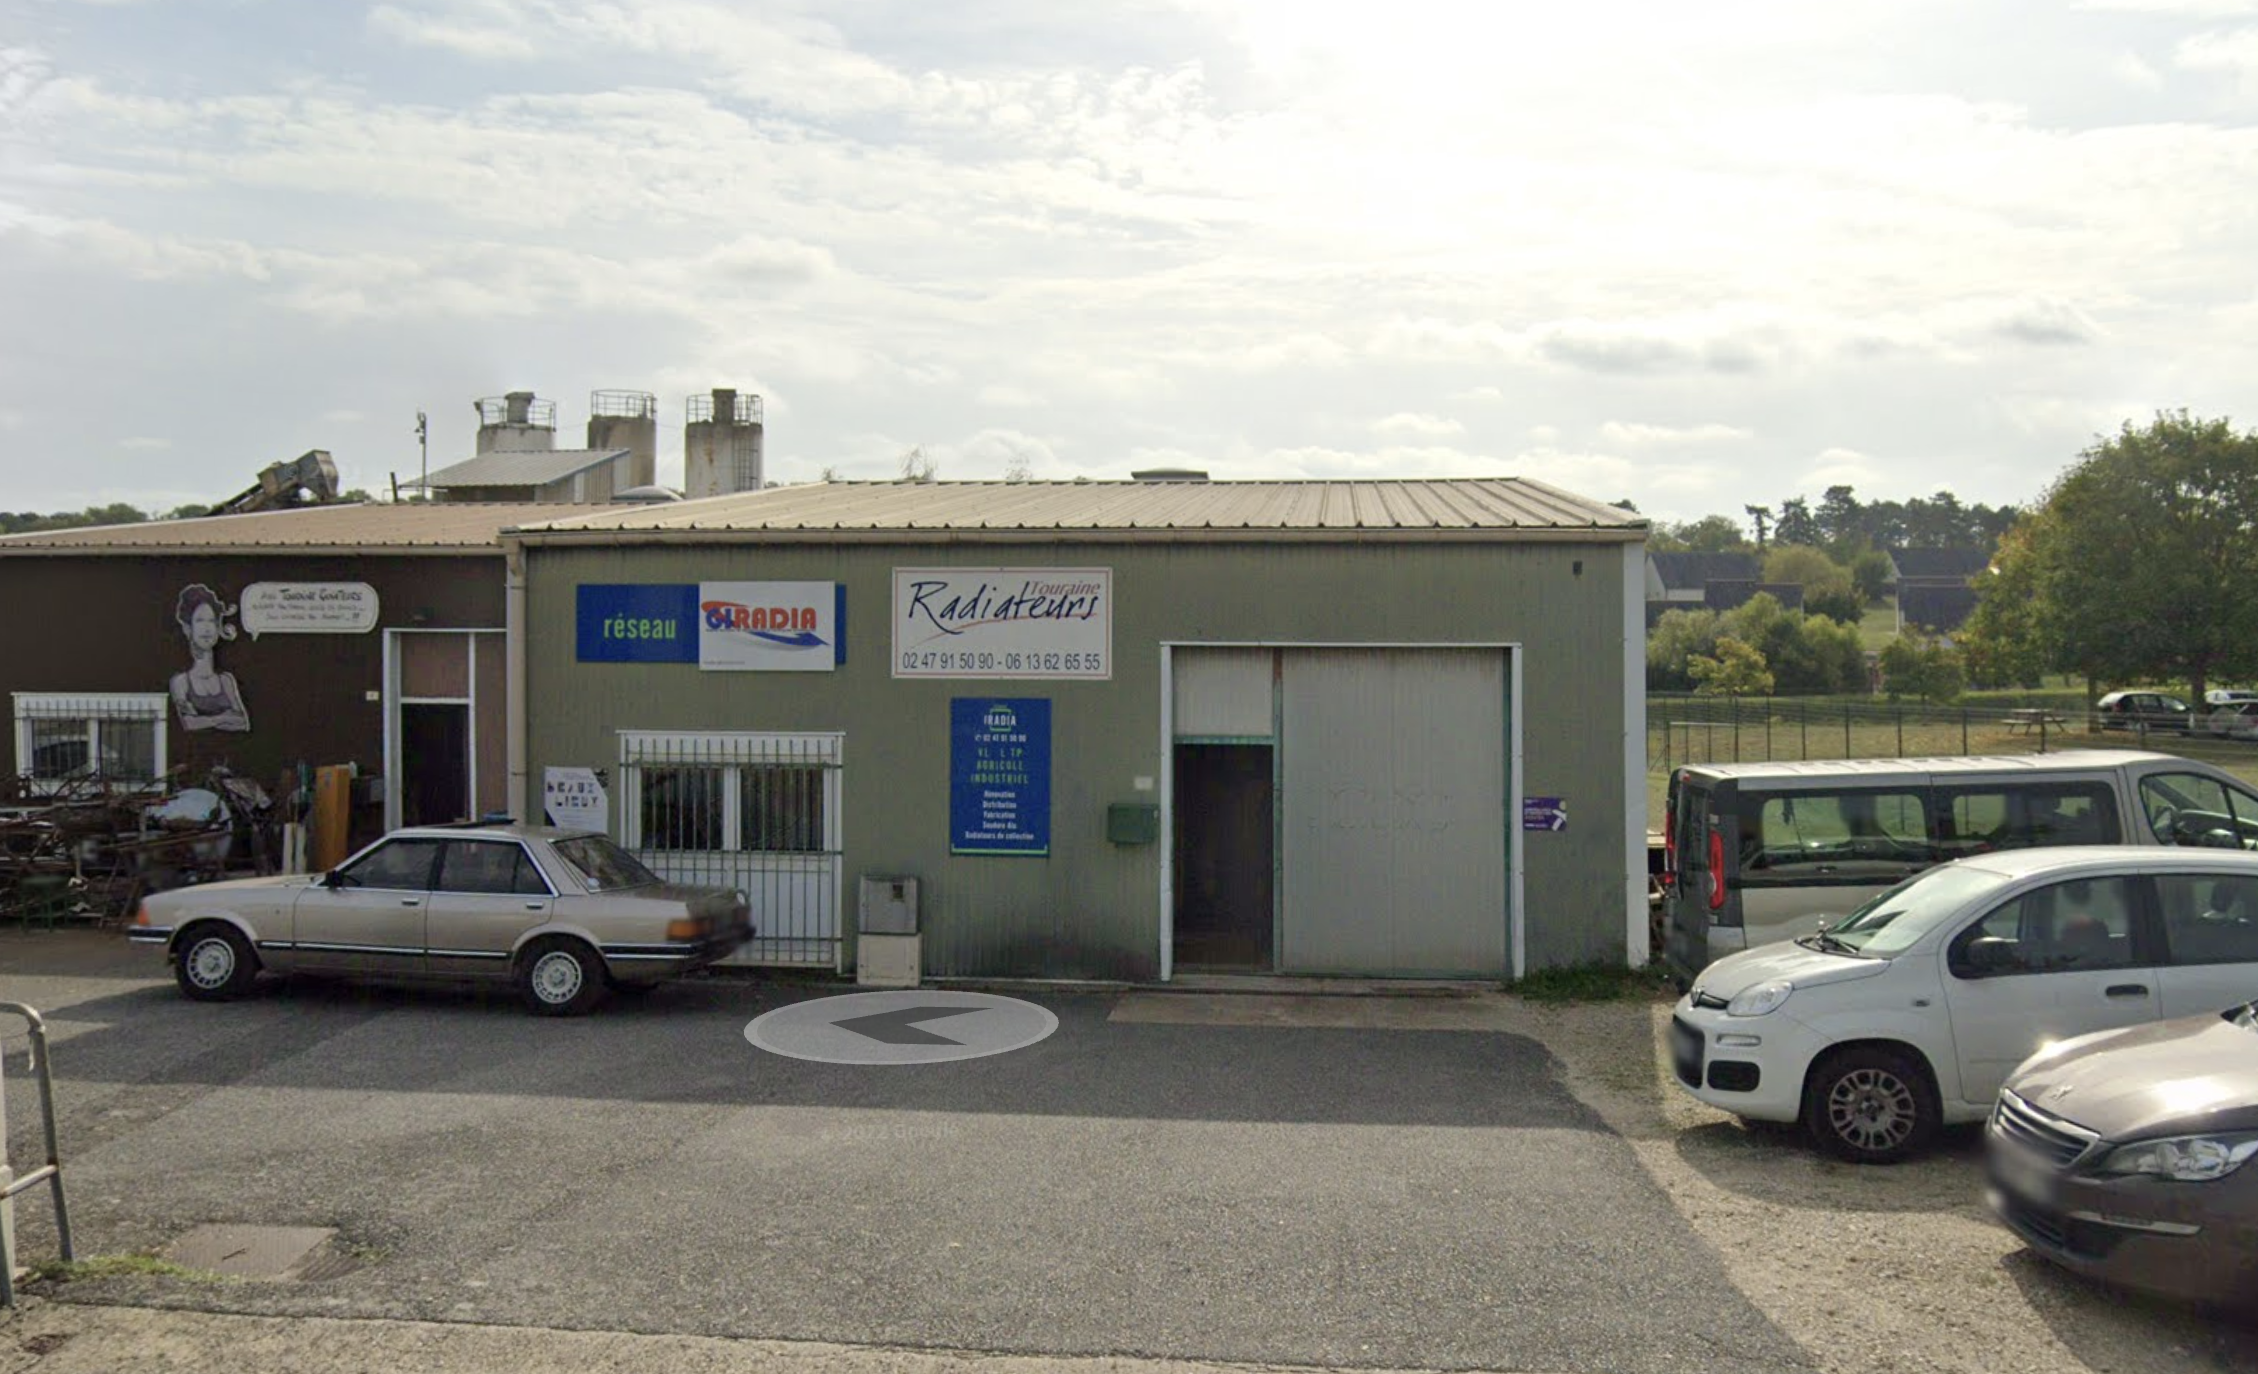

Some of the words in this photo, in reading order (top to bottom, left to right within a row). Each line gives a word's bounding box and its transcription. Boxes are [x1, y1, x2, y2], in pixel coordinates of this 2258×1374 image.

[1030, 581, 1101, 596] Touraine
[705, 607, 816, 630] GIRADIA
[908, 580, 1099, 635] Radiateurs
[603, 612, 676, 639] réseau
[902, 653, 918, 670] 02
[921, 653, 937, 670] 47
[940, 653, 955, 670] 91
[959, 653, 975, 670] 50
[978, 653, 994, 670] 90
[1005, 653, 1021, 670] 06
[1026, 653, 1040, 670] 13
[1044, 653, 1060, 670] 62
[1065, 653, 1080, 670] 65
[1084, 653, 1100, 670] 55
